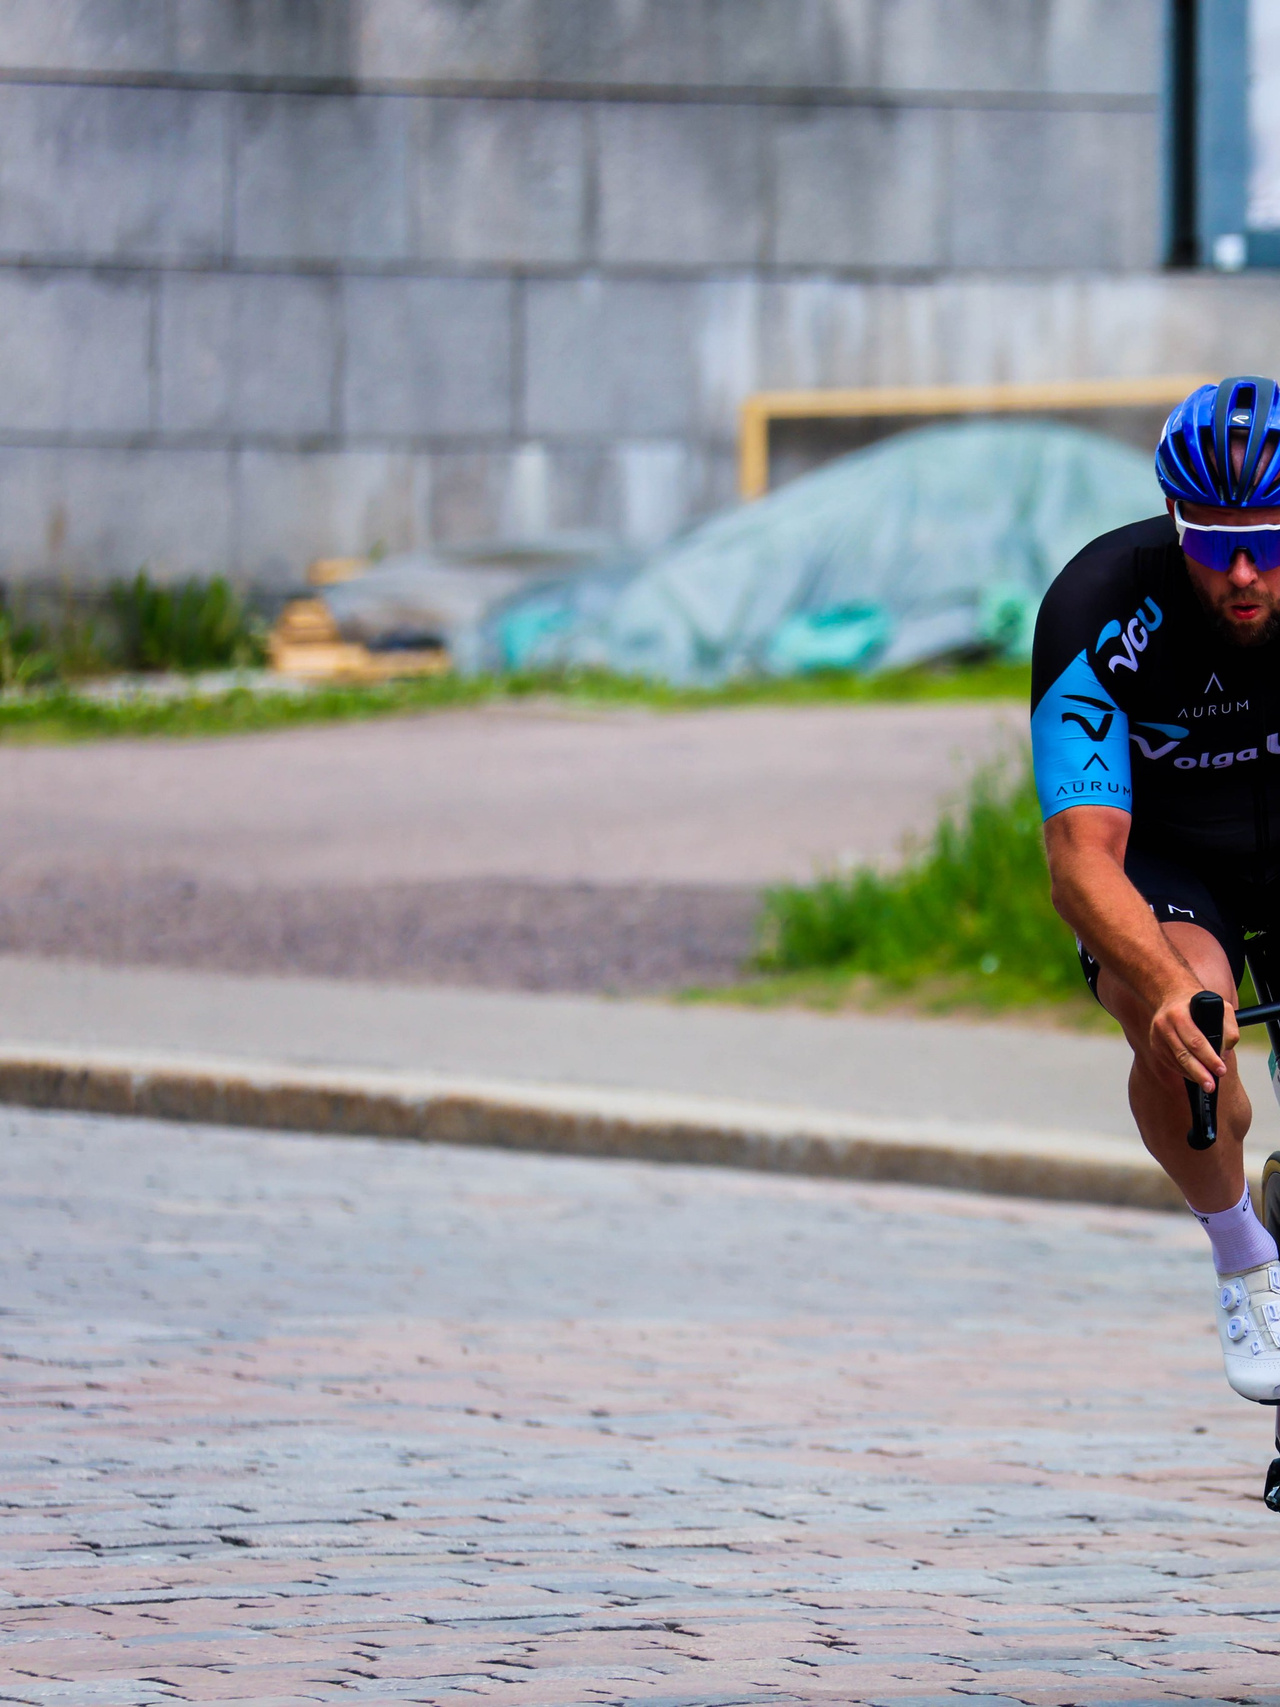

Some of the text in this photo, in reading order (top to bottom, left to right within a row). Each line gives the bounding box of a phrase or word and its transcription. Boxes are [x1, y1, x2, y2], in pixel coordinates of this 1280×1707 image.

[1108, 596, 1163, 673] VGU
[1178, 700, 1249, 719] AURUM
[1129, 733, 1258, 770] Volga
[1056, 780, 1131, 798] AURUM
